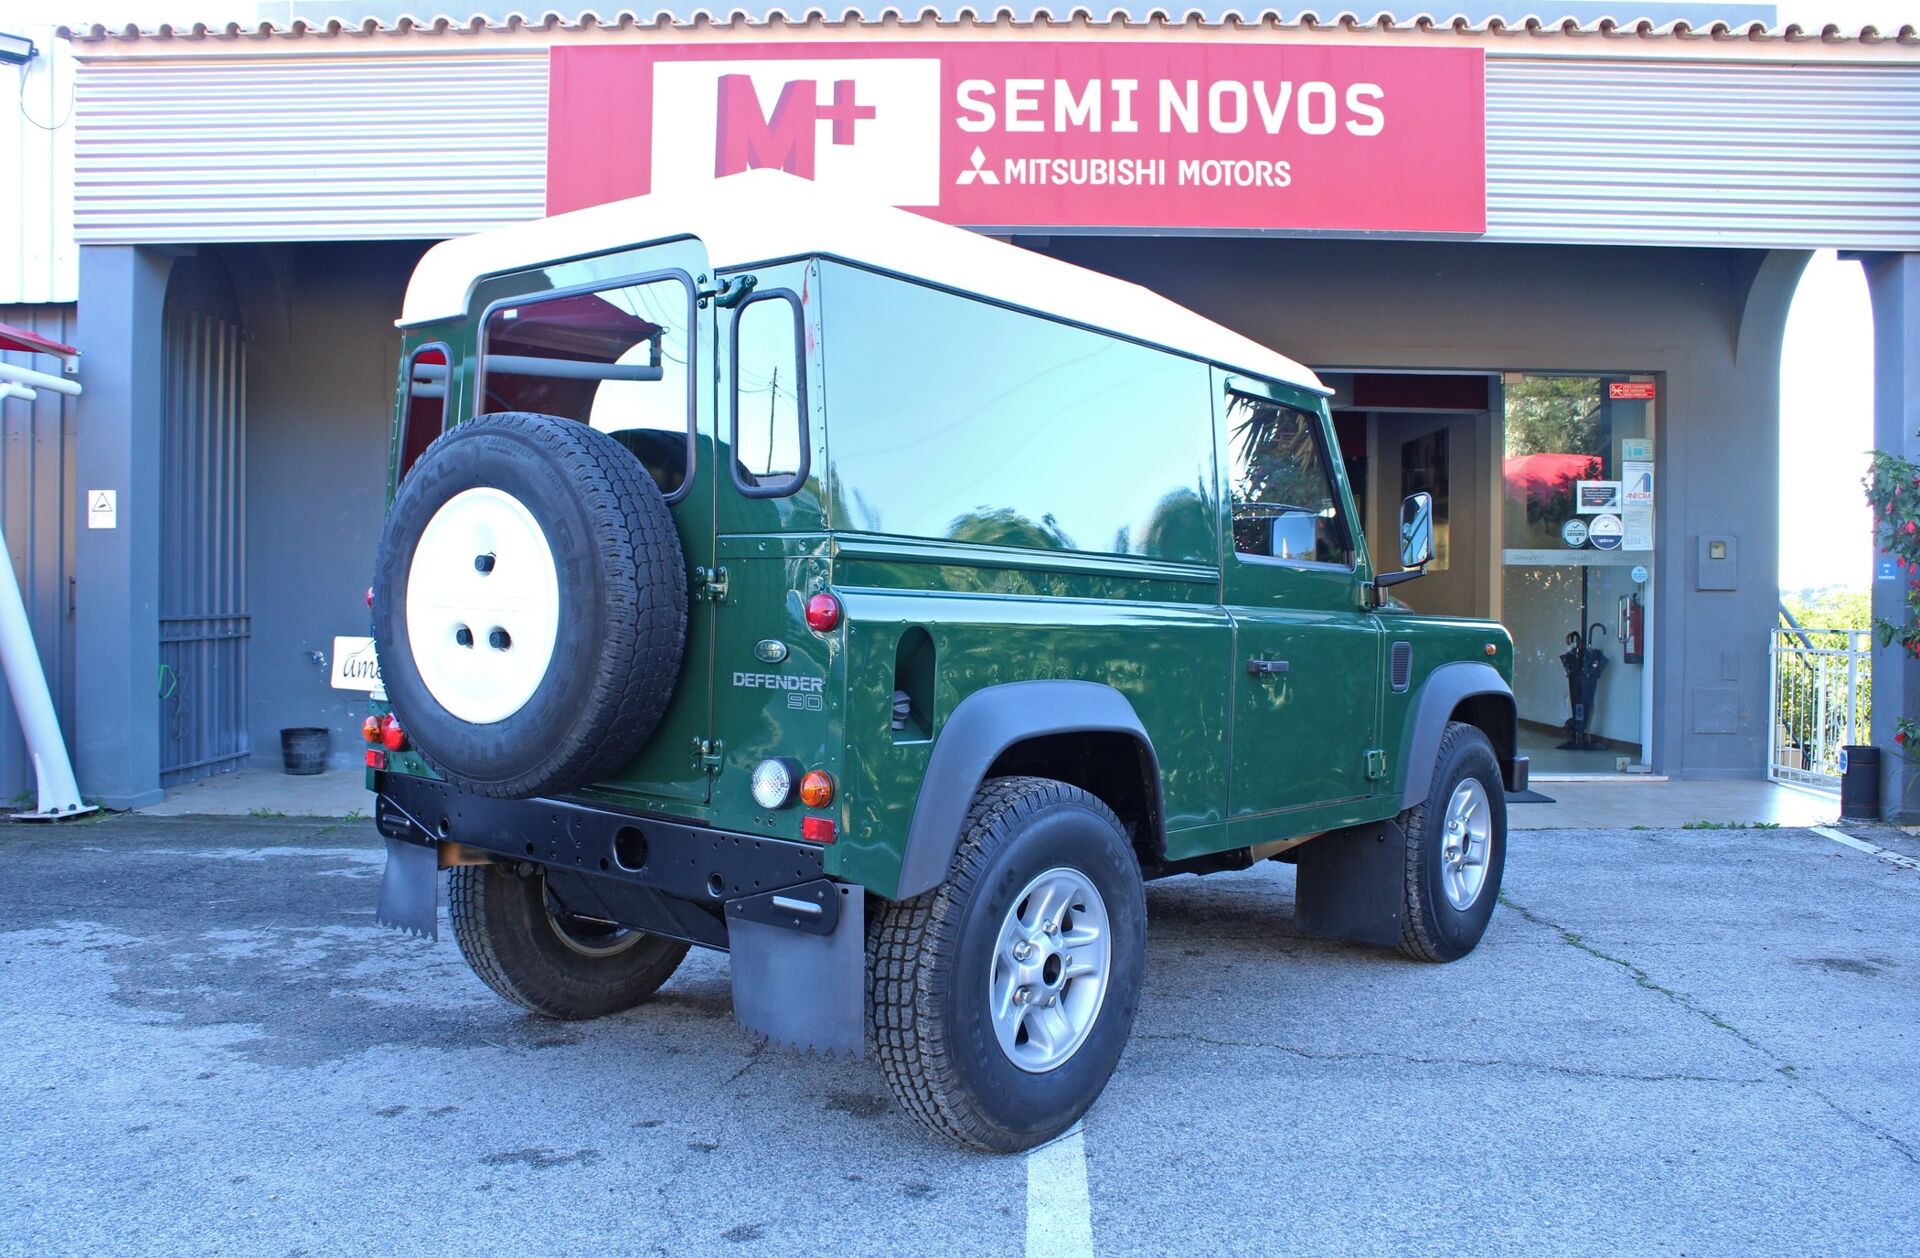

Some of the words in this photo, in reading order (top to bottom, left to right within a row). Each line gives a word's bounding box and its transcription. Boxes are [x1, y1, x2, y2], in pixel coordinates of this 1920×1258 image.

[955, 78, 1138, 133] SEMI
[1158, 79, 1385, 136] NOVOS
[1005, 158, 1165, 186] MITSUBISHI
[1178, 159, 1292, 187] MOTORS
[733, 672, 823, 692] DEFENDER
[787, 692, 823, 711] 90
